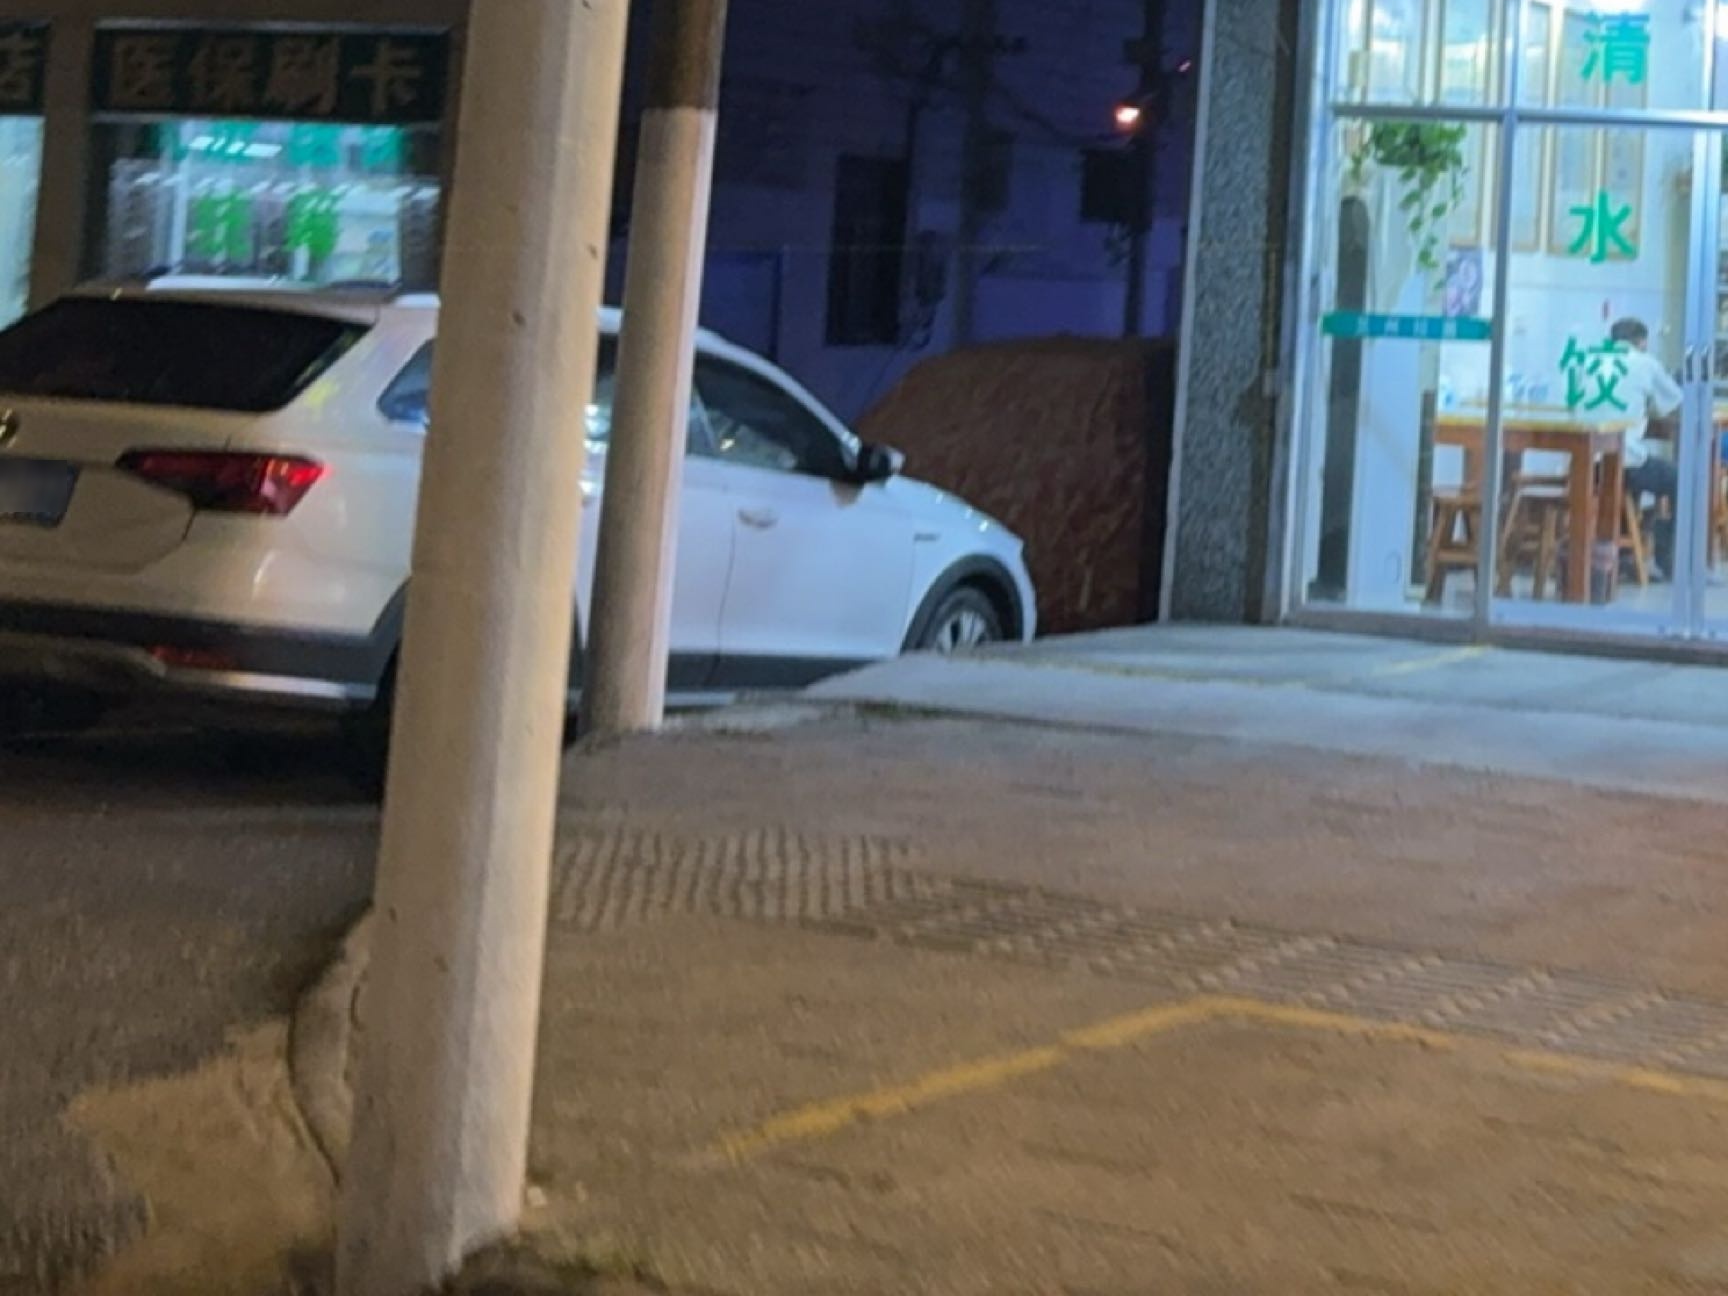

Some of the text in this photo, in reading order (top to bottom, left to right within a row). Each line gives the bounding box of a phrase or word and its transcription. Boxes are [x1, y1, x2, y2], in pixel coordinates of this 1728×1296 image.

[113, 32, 424, 115] 医保刷卡
[1559, 188, 1640, 411] 水饺
